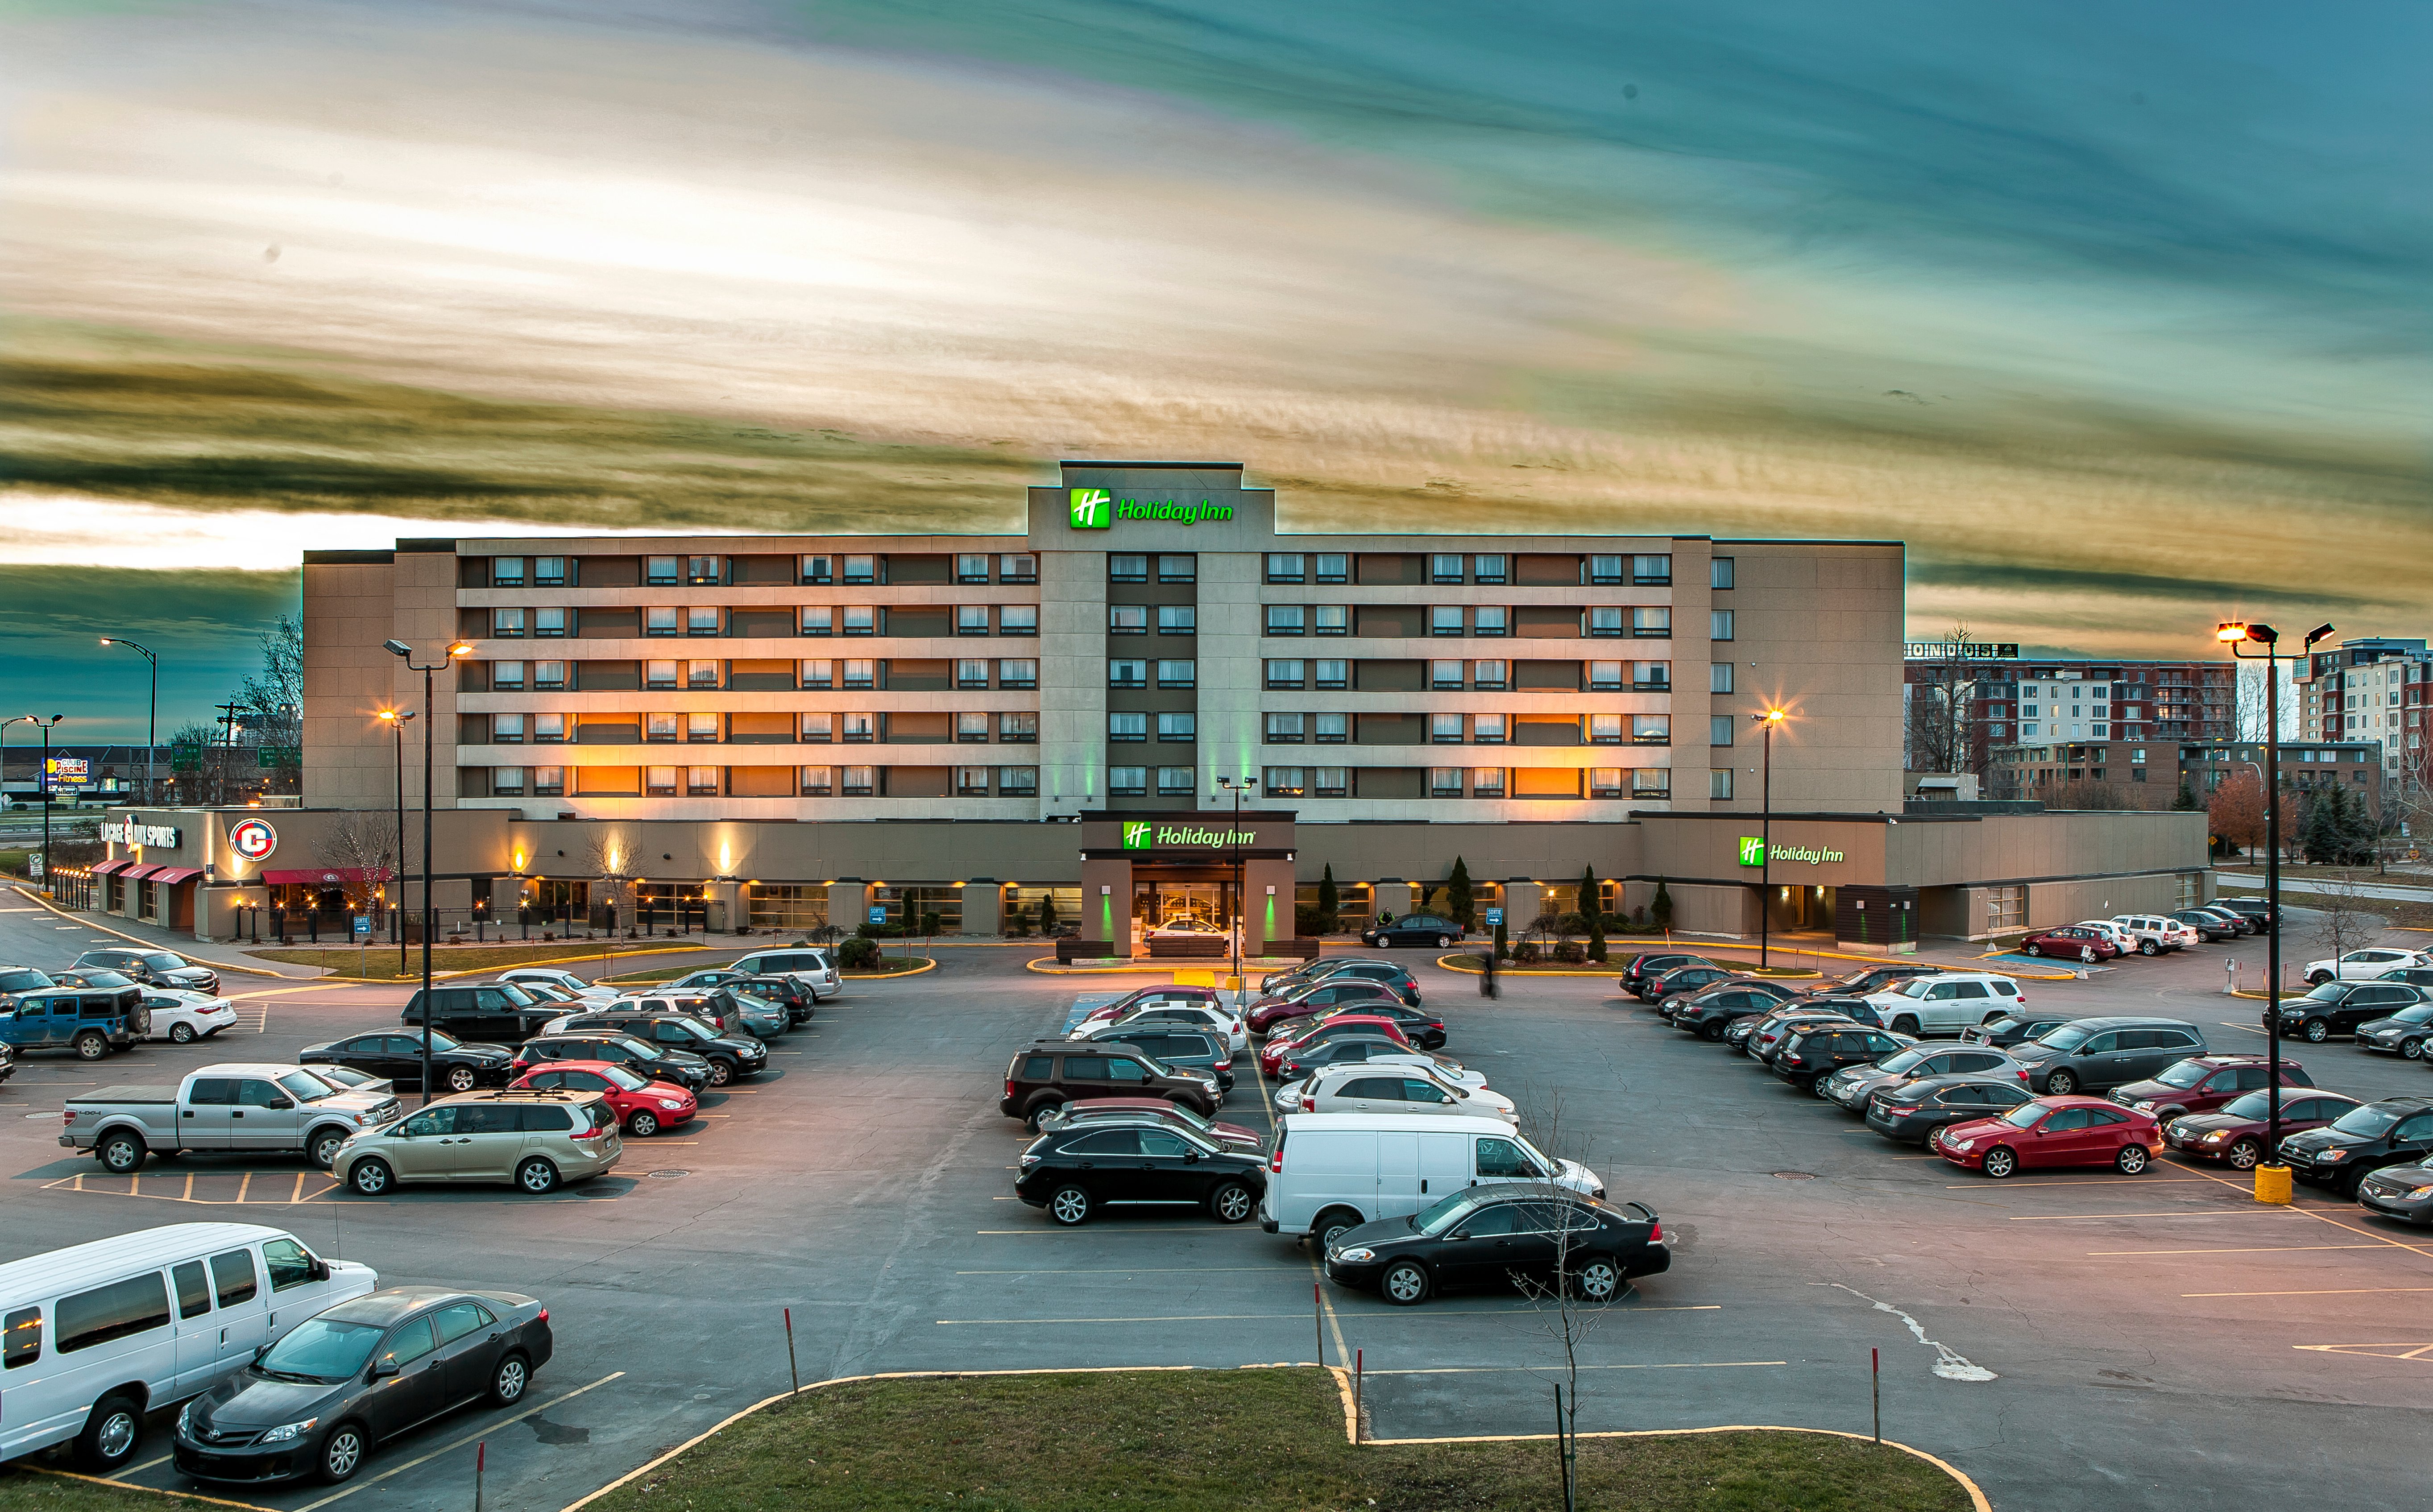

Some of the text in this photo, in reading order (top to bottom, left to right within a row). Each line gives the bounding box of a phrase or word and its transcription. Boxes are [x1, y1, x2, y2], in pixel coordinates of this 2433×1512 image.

[1117, 498, 1233, 525] Holiday Inn
[1904, 644, 1990, 657] ONDOS
[56, 761, 87, 773] PISCINE
[101, 822, 108, 841] LA
[108, 823, 124, 843] CAGE
[134, 824, 147, 846] AUX
[147, 825, 175, 848] SPORTS
[1157, 827, 1255, 849] Holiday Inn
[1770, 845, 1844, 865] Holiday Inn
